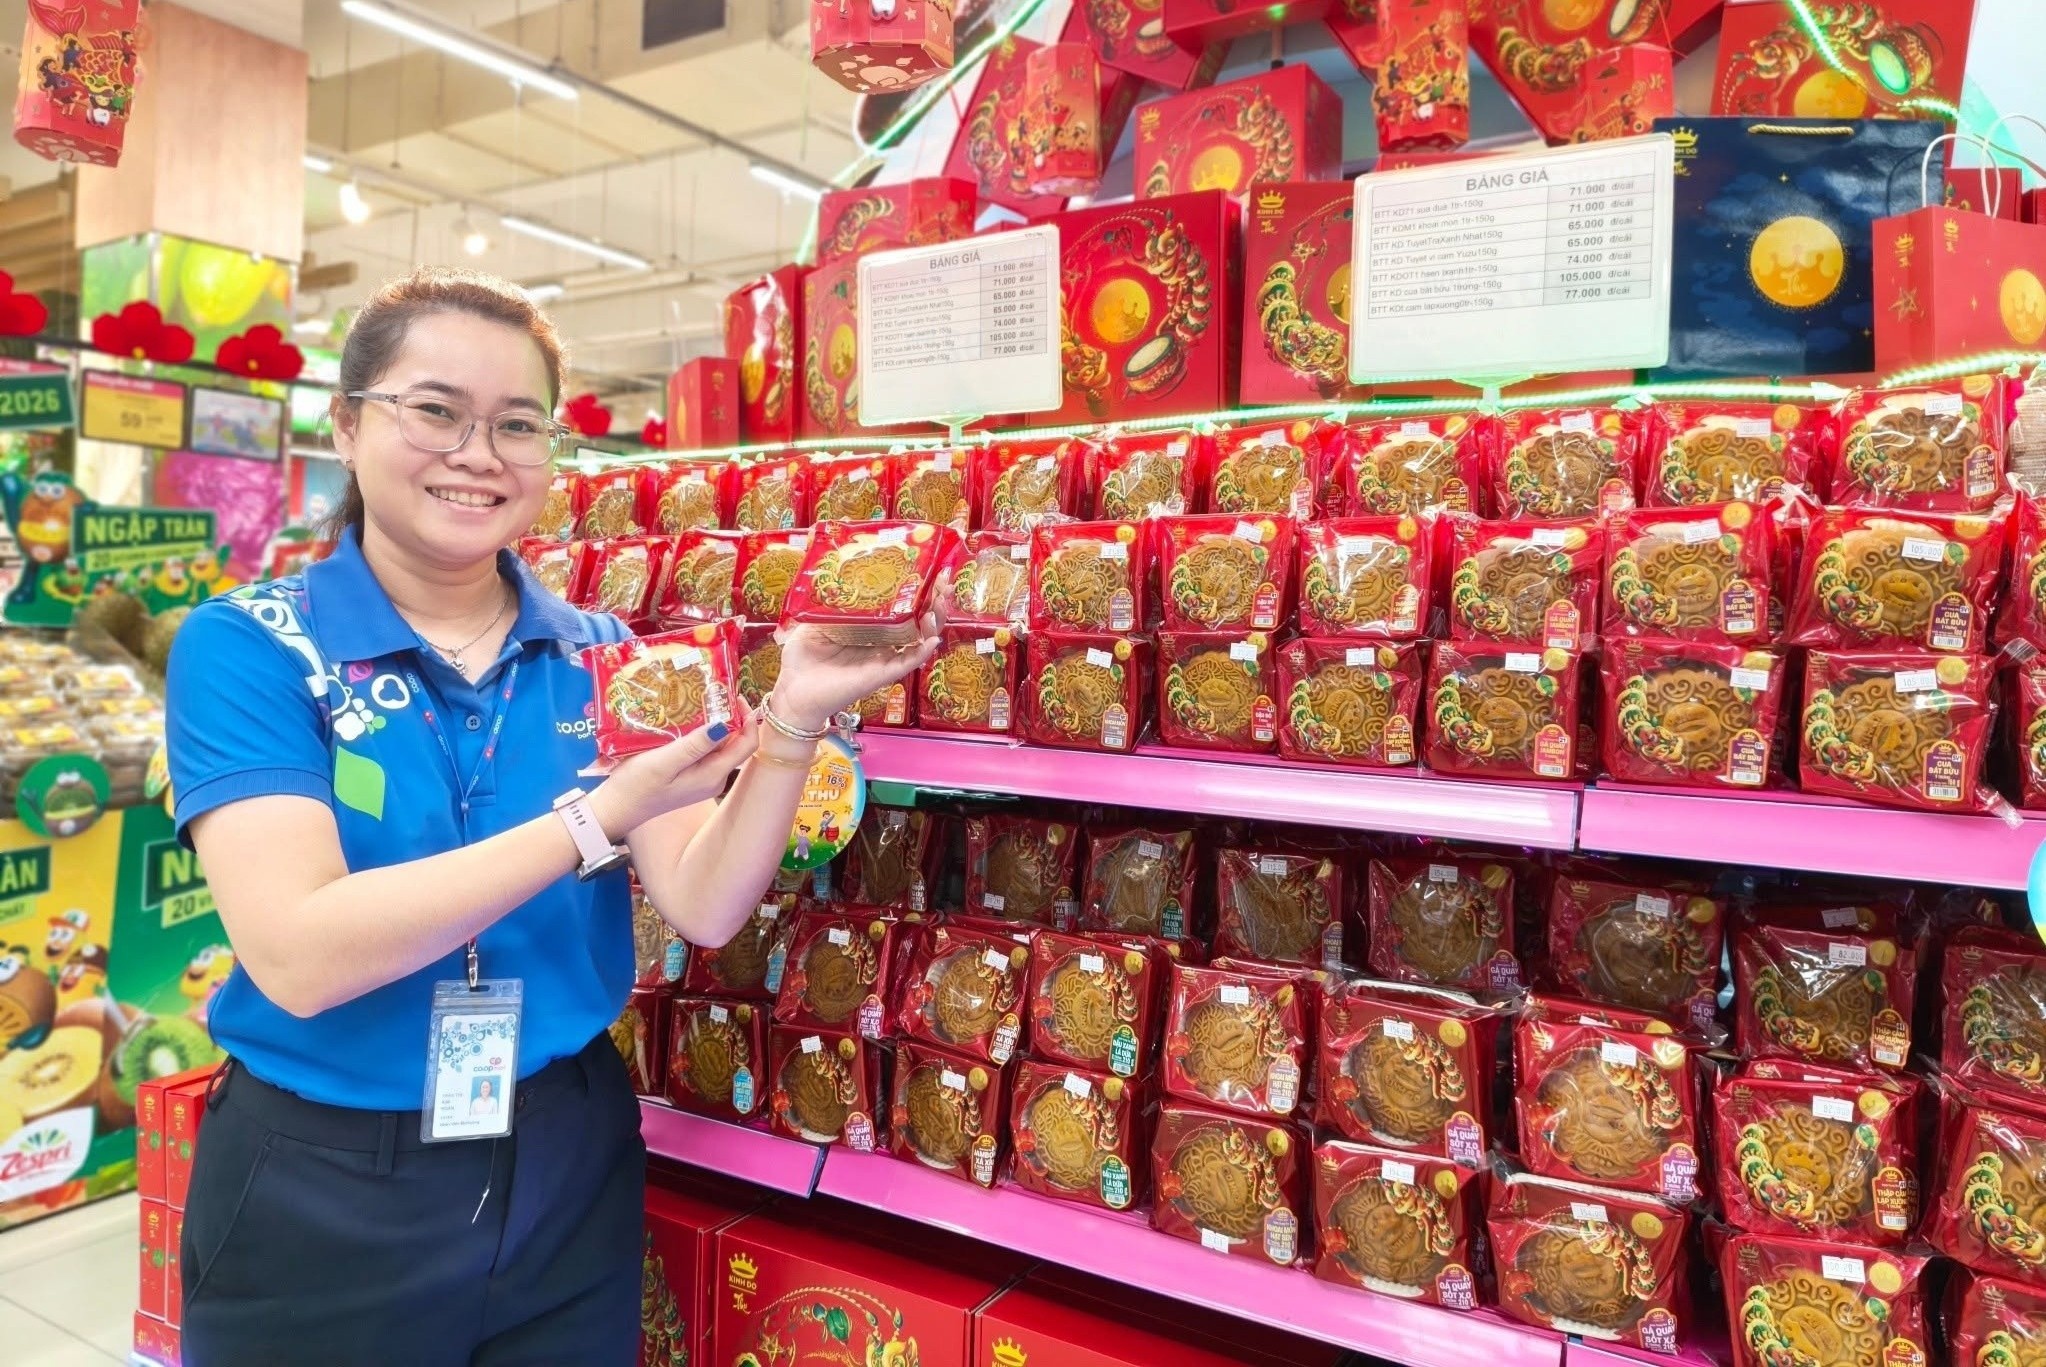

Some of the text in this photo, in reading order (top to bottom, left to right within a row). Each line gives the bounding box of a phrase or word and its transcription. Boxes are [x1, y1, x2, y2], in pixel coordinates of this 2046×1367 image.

[1466, 166, 1550, 191] BẢNG GIÁ
[1570, 183, 1605, 196] 71.000
[1570, 201, 1604, 213] 71.000
[1568, 218, 1604, 230] 65.000
[1567, 235, 1603, 248] 65.000
[961, 250, 981, 264] GIÁ
[1567, 252, 1602, 265] 74.000
[1560, 270, 1602, 283] 105.000
[1565, 287, 1601, 299] 77.000
[0, 388, 60, 416] 2026
[85, 511, 157, 547] NGẬP
[1938, 760, 1952, 768] CUA
[807, 789, 841, 802] THU
[0, 855, 38, 893] ÀN
[1448, 1127, 1479, 1141] GÀ QUAY
[0, 1140, 73, 1181] Zespri
[1683, 1176, 1694, 1184] X.
[1440, 1280, 1472, 1292] GÀ QUAY
[1656, 1324, 1675, 1336] QUAY
